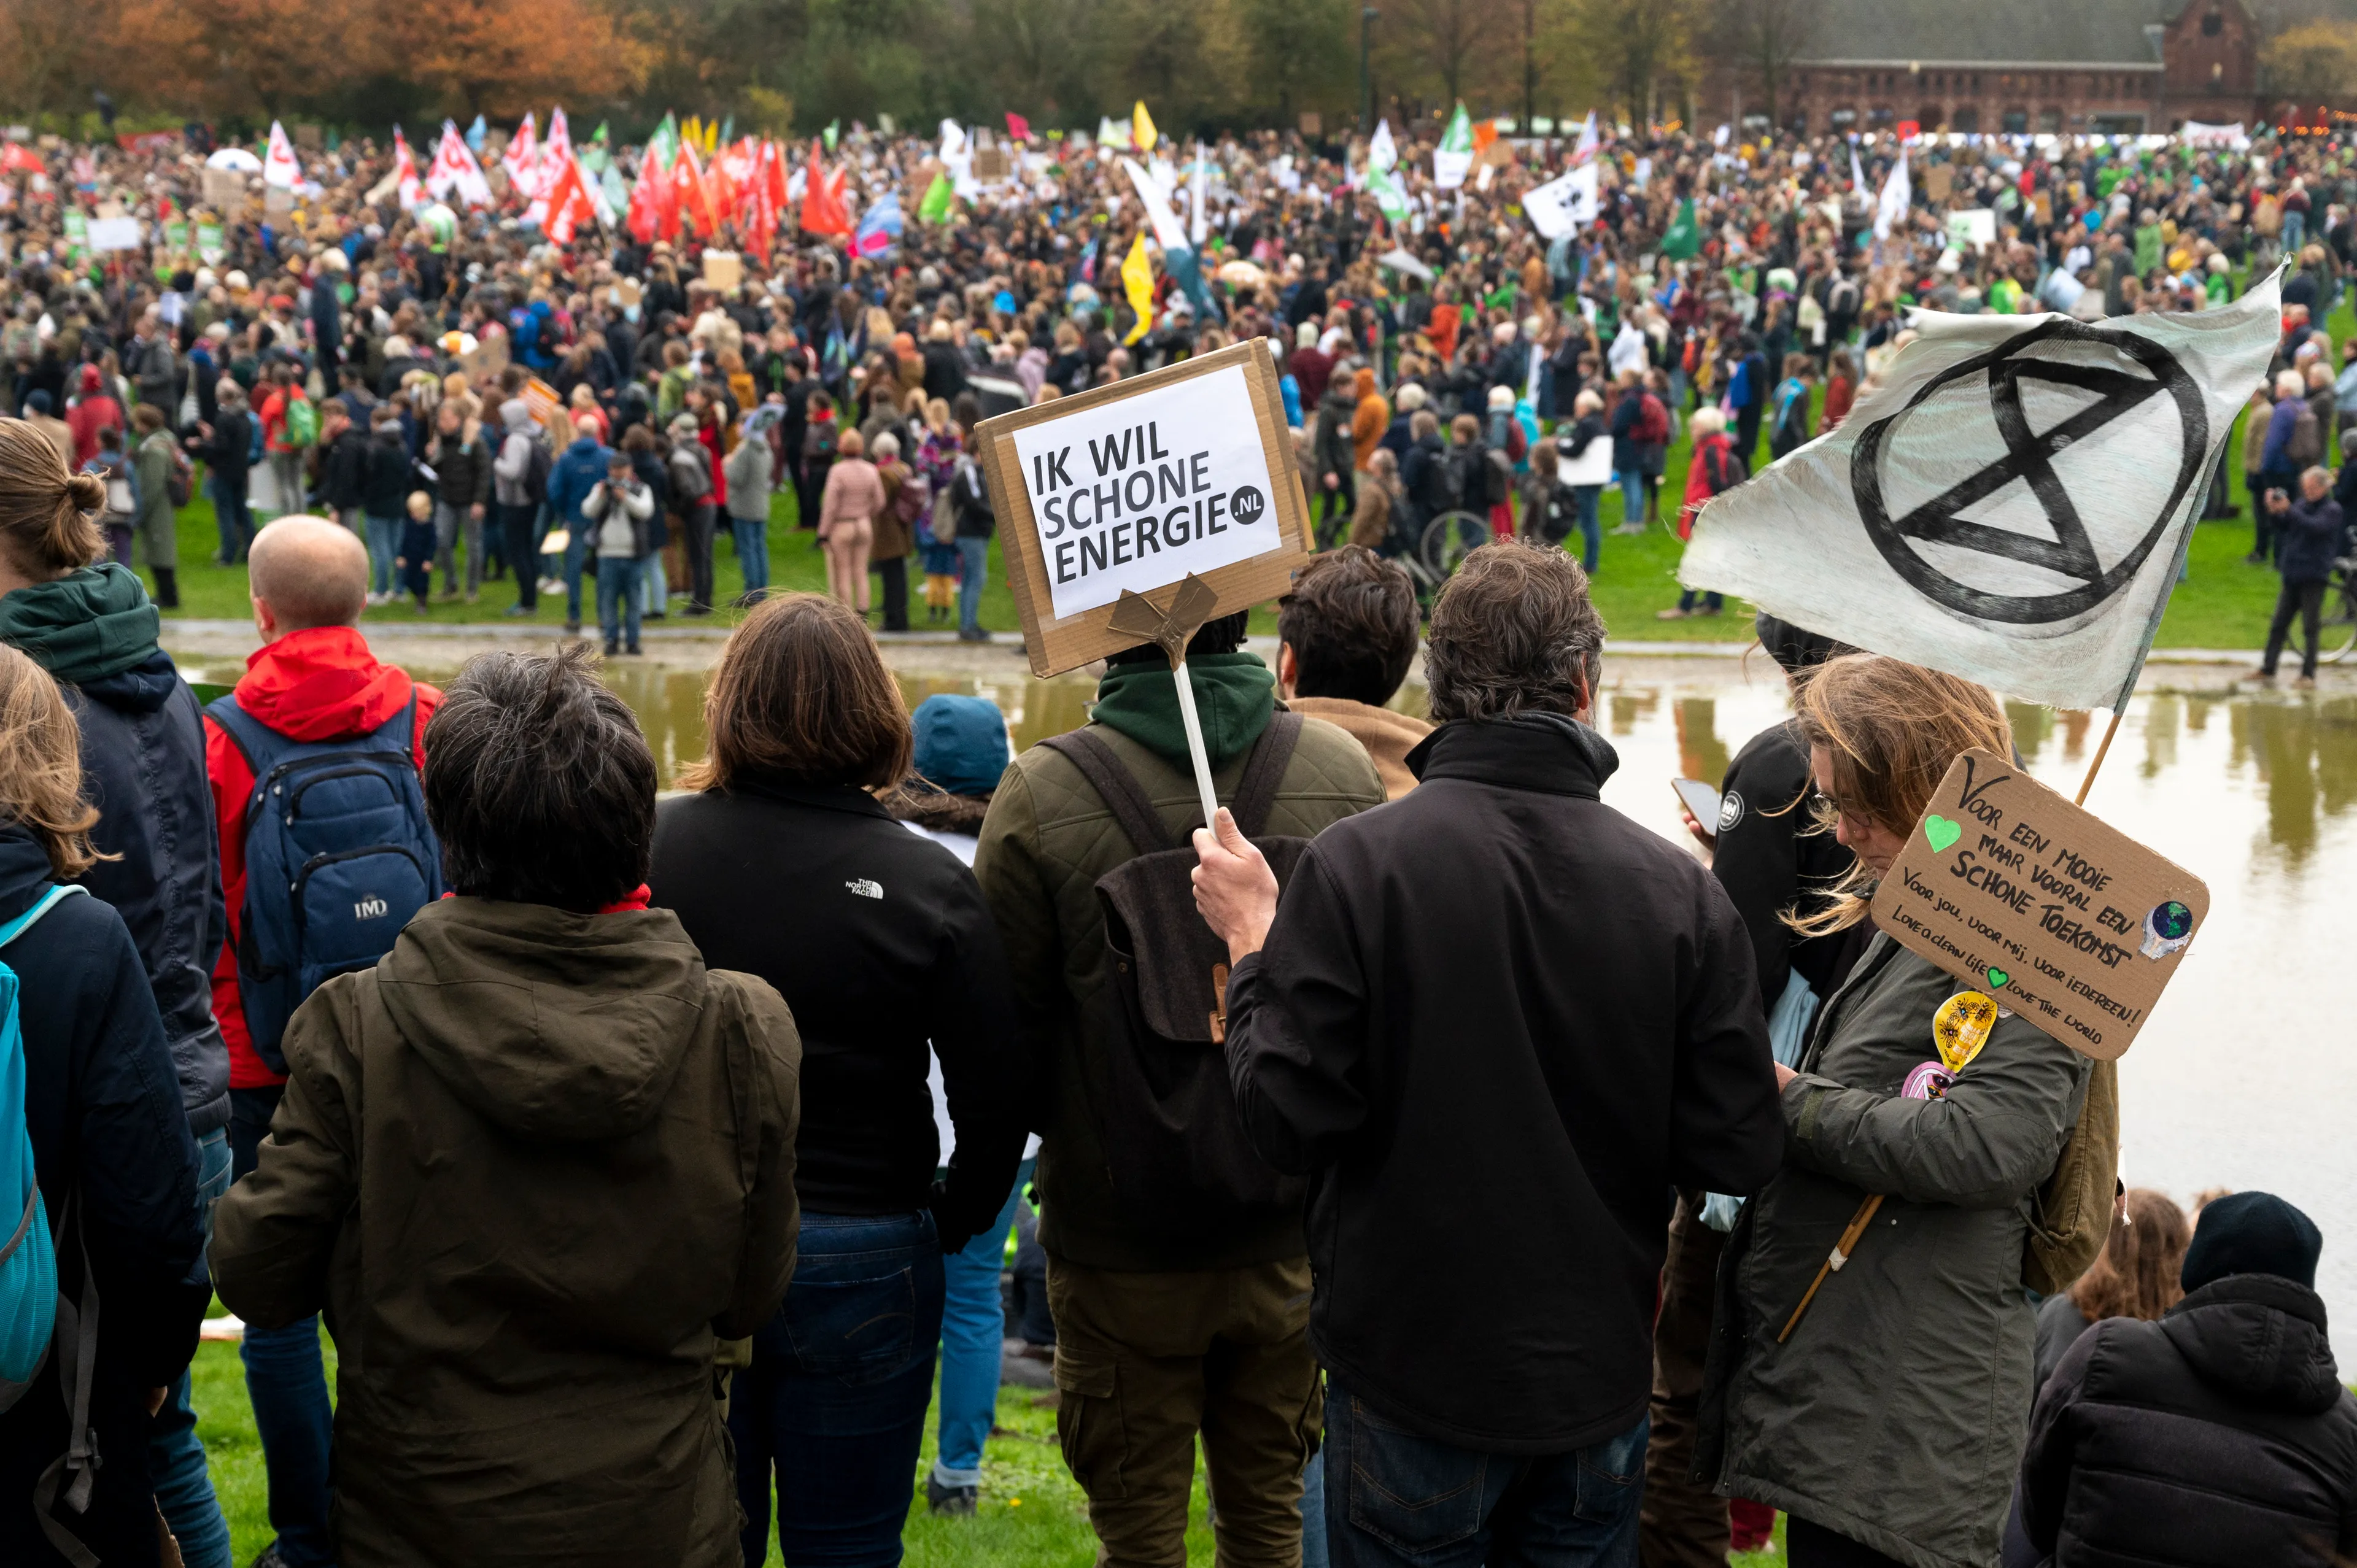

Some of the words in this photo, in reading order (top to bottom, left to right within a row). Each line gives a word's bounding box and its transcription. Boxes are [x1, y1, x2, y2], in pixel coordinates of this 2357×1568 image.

[1034, 446, 1074, 496] IK
[1088, 421, 1169, 477] WIL
[1044, 450, 1211, 539] SCHONE
[1055, 492, 1228, 584] ENERGIE
[2009, 822, 2051, 853] EEN
[845, 881, 872, 892] NORTH
[852, 888, 870, 897] FACE
[1950, 851, 2036, 915] SCHONE
[2039, 905, 2132, 968] TOEKOMST
[1978, 834, 2024, 875] MAAR
[2030, 864, 2091, 912] VOORAL
[2096, 905, 2135, 935] EEN
[2037, 998, 2062, 1019] THE
